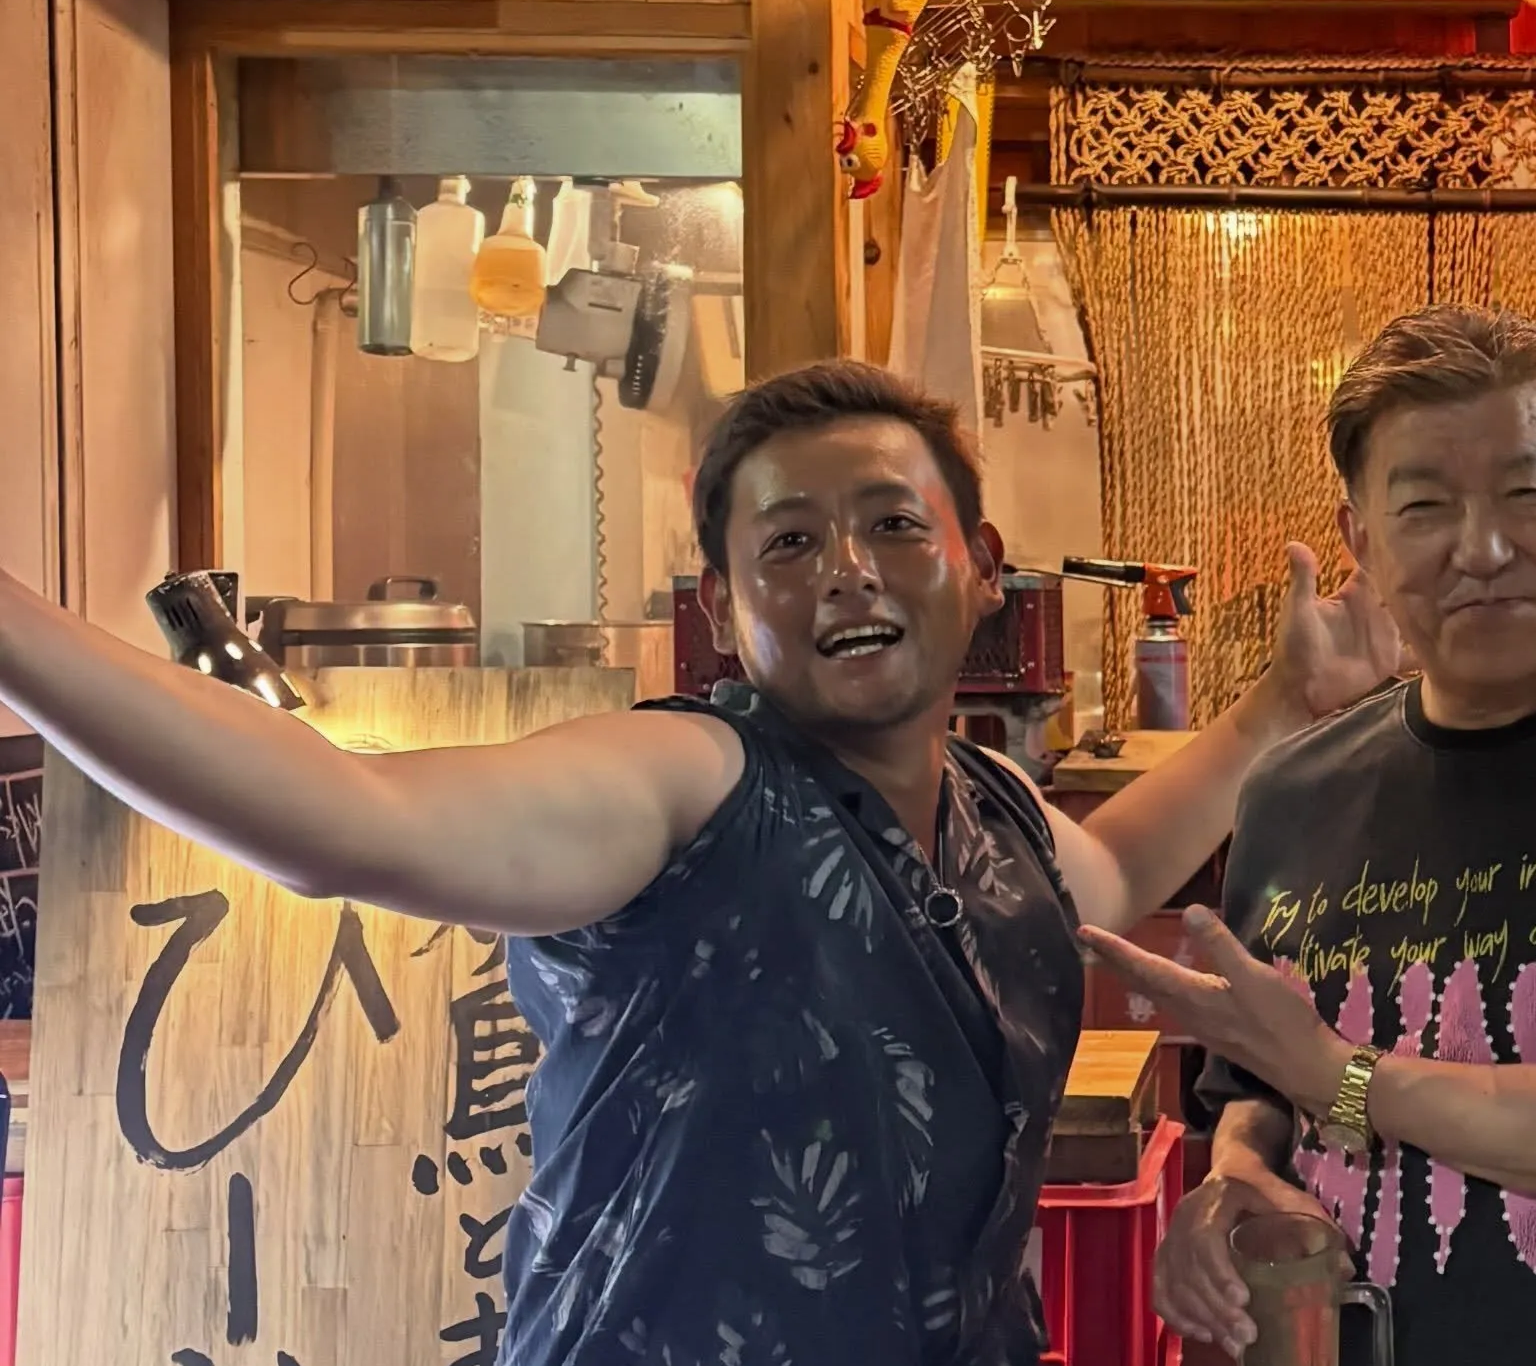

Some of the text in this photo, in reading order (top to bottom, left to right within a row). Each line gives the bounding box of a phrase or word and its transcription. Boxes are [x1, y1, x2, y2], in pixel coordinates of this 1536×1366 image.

[1261, 890, 1301, 950] Try
[1307, 882, 1328, 924] to
[1342, 853, 1438, 926] develop
[1454, 866, 1502, 928] your
[1387, 935, 1448, 997] your
[1464, 919, 1509, 985] way
